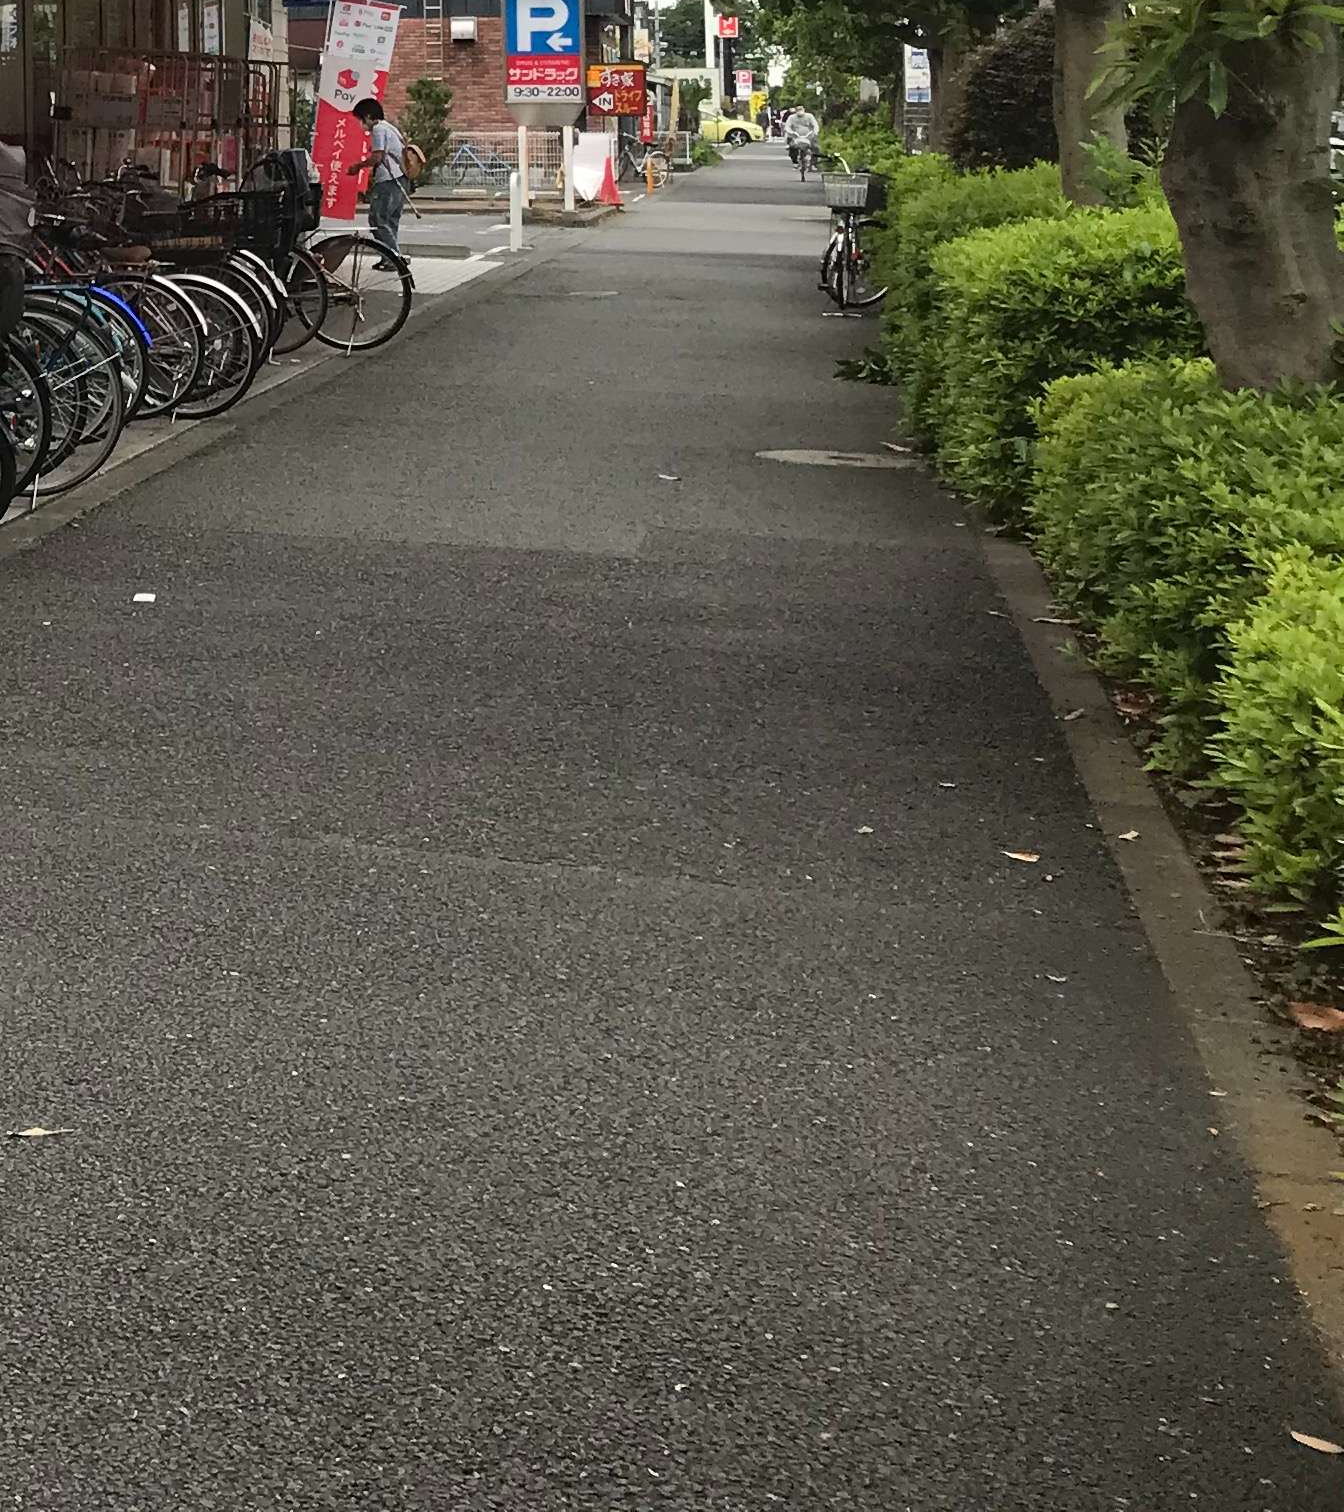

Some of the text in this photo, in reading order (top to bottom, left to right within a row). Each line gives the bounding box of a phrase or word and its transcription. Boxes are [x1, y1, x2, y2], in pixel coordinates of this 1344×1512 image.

[600, 67, 634, 89] すき家
[334, 88, 356, 104] Pay
[598, 97, 612, 107] IN
[325, 118, 348, 209] メルペイ使えます
